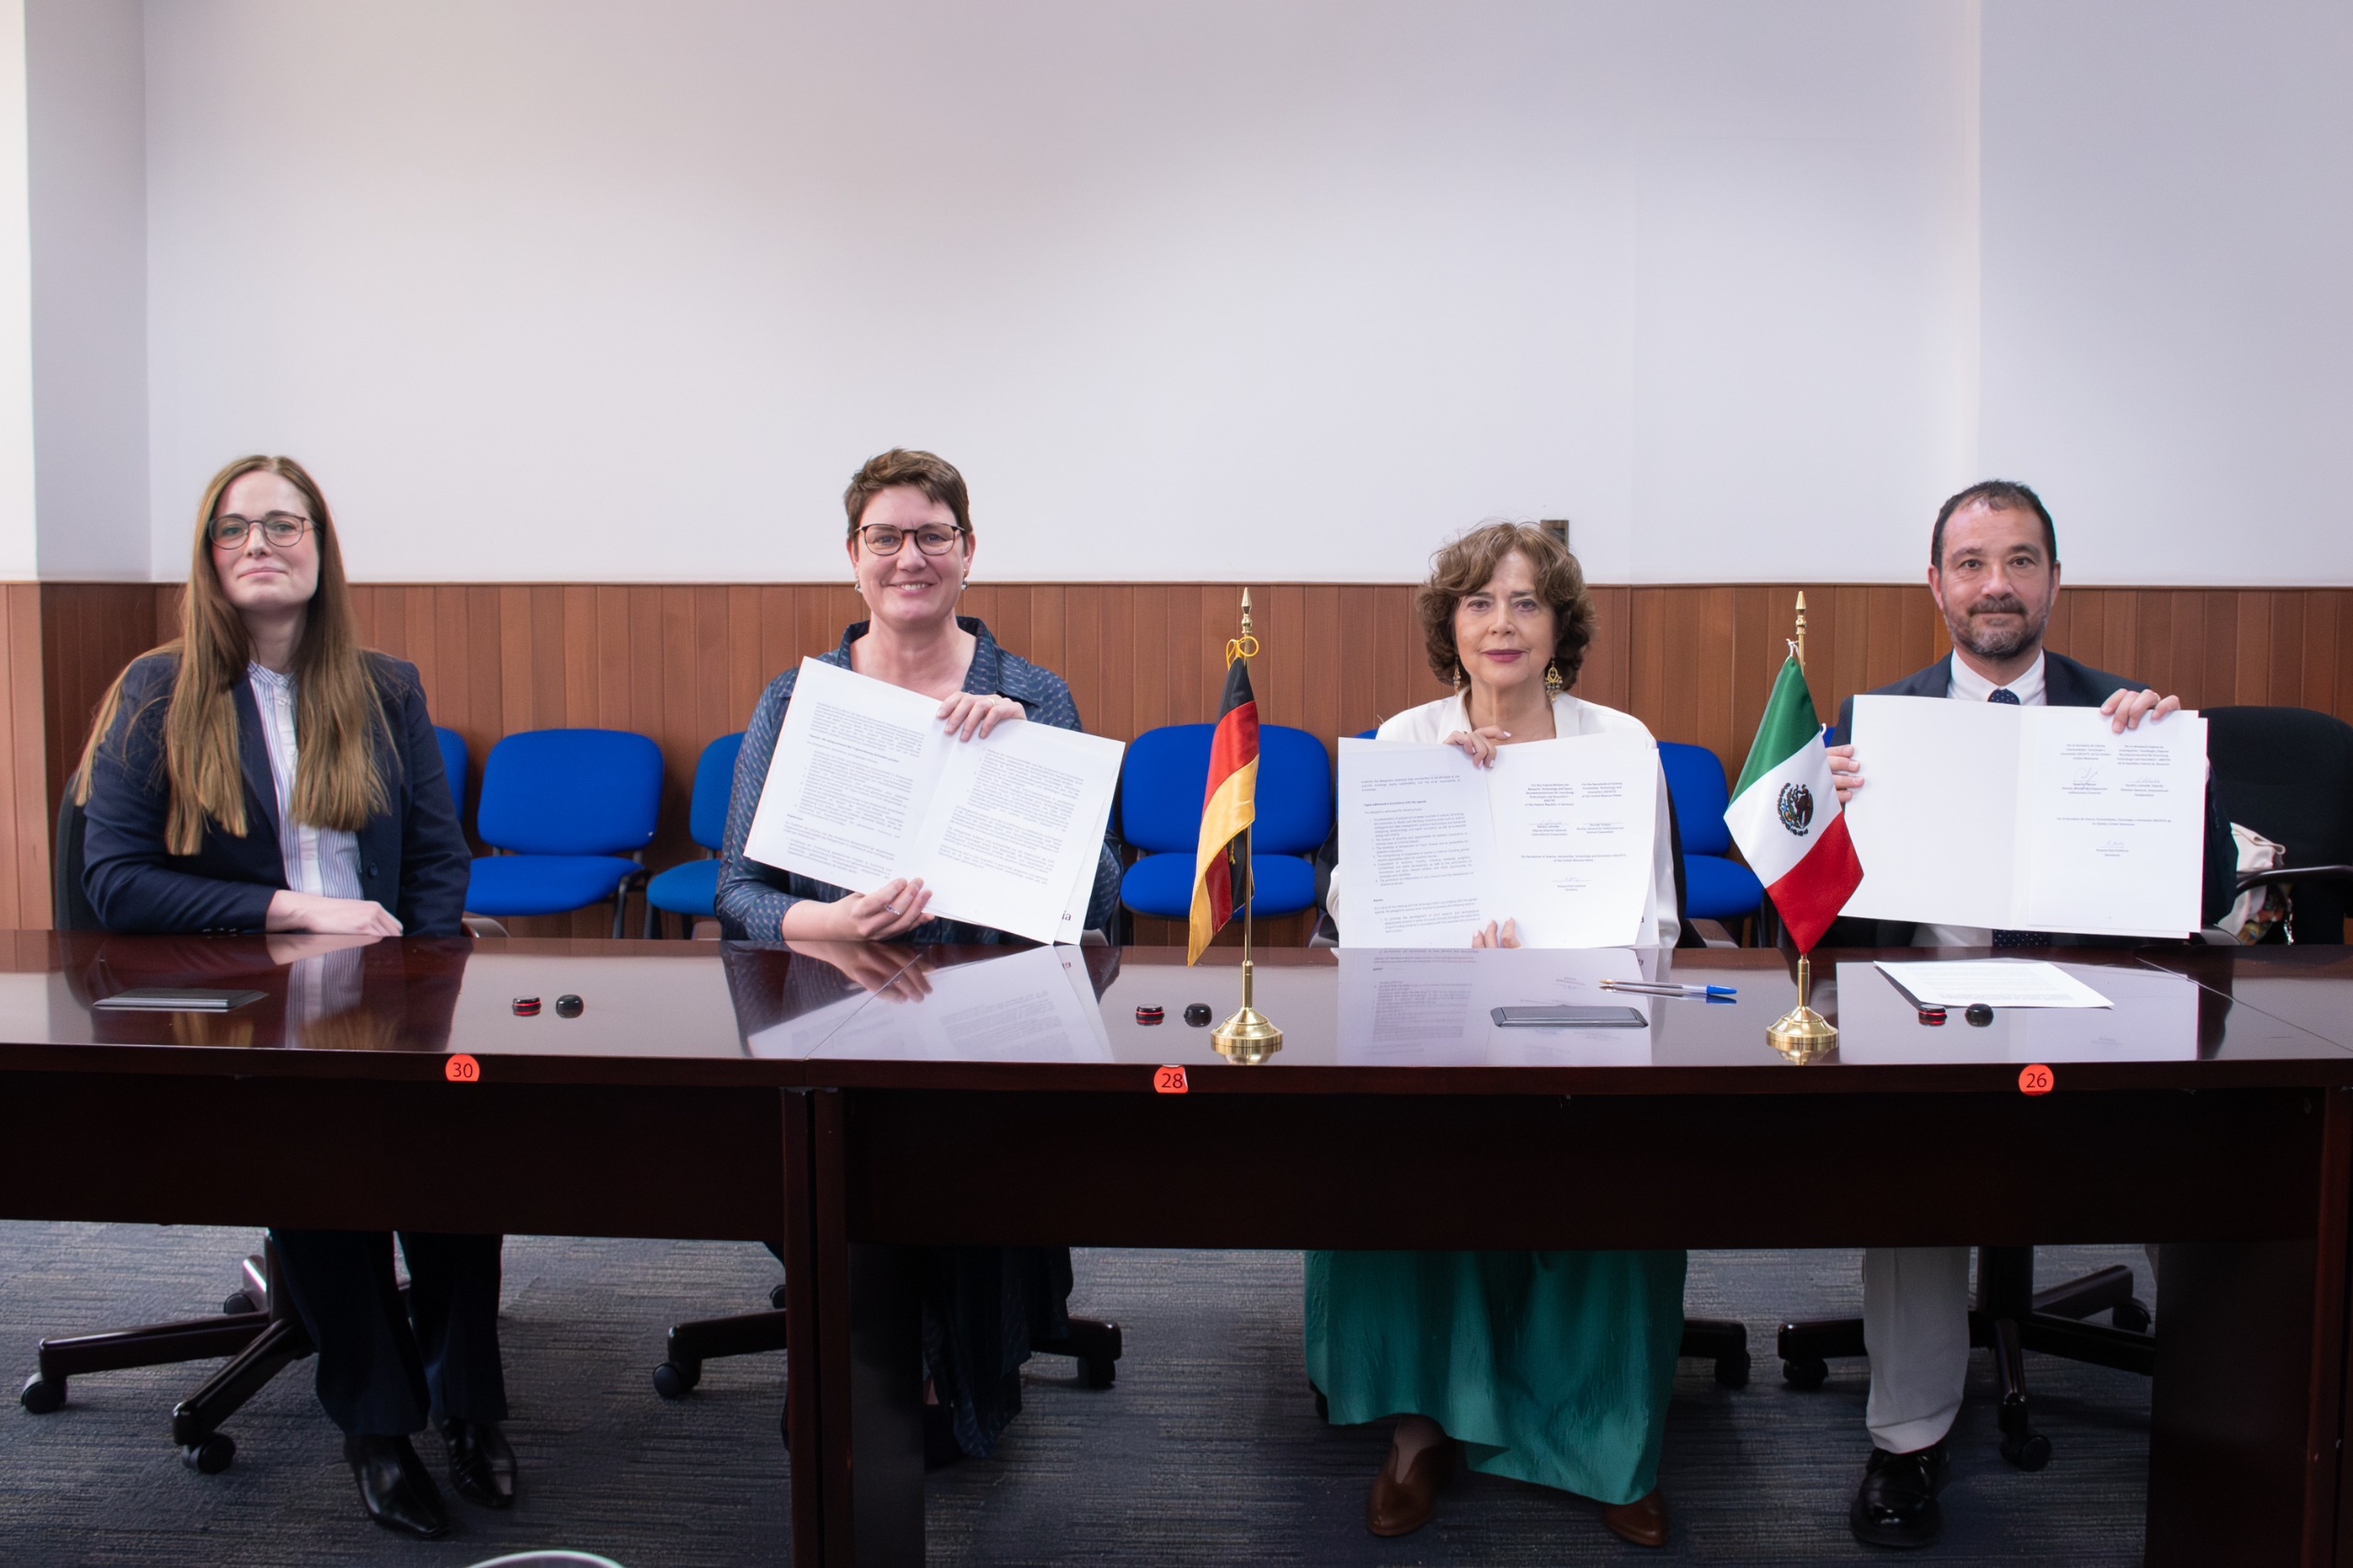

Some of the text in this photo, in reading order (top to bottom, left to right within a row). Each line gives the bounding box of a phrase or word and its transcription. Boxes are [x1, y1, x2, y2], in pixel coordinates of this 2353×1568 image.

[452, 1062, 473, 1078] 30
[1161, 1073, 1183, 1089] 28
[2026, 1072, 2047, 1088] 26
